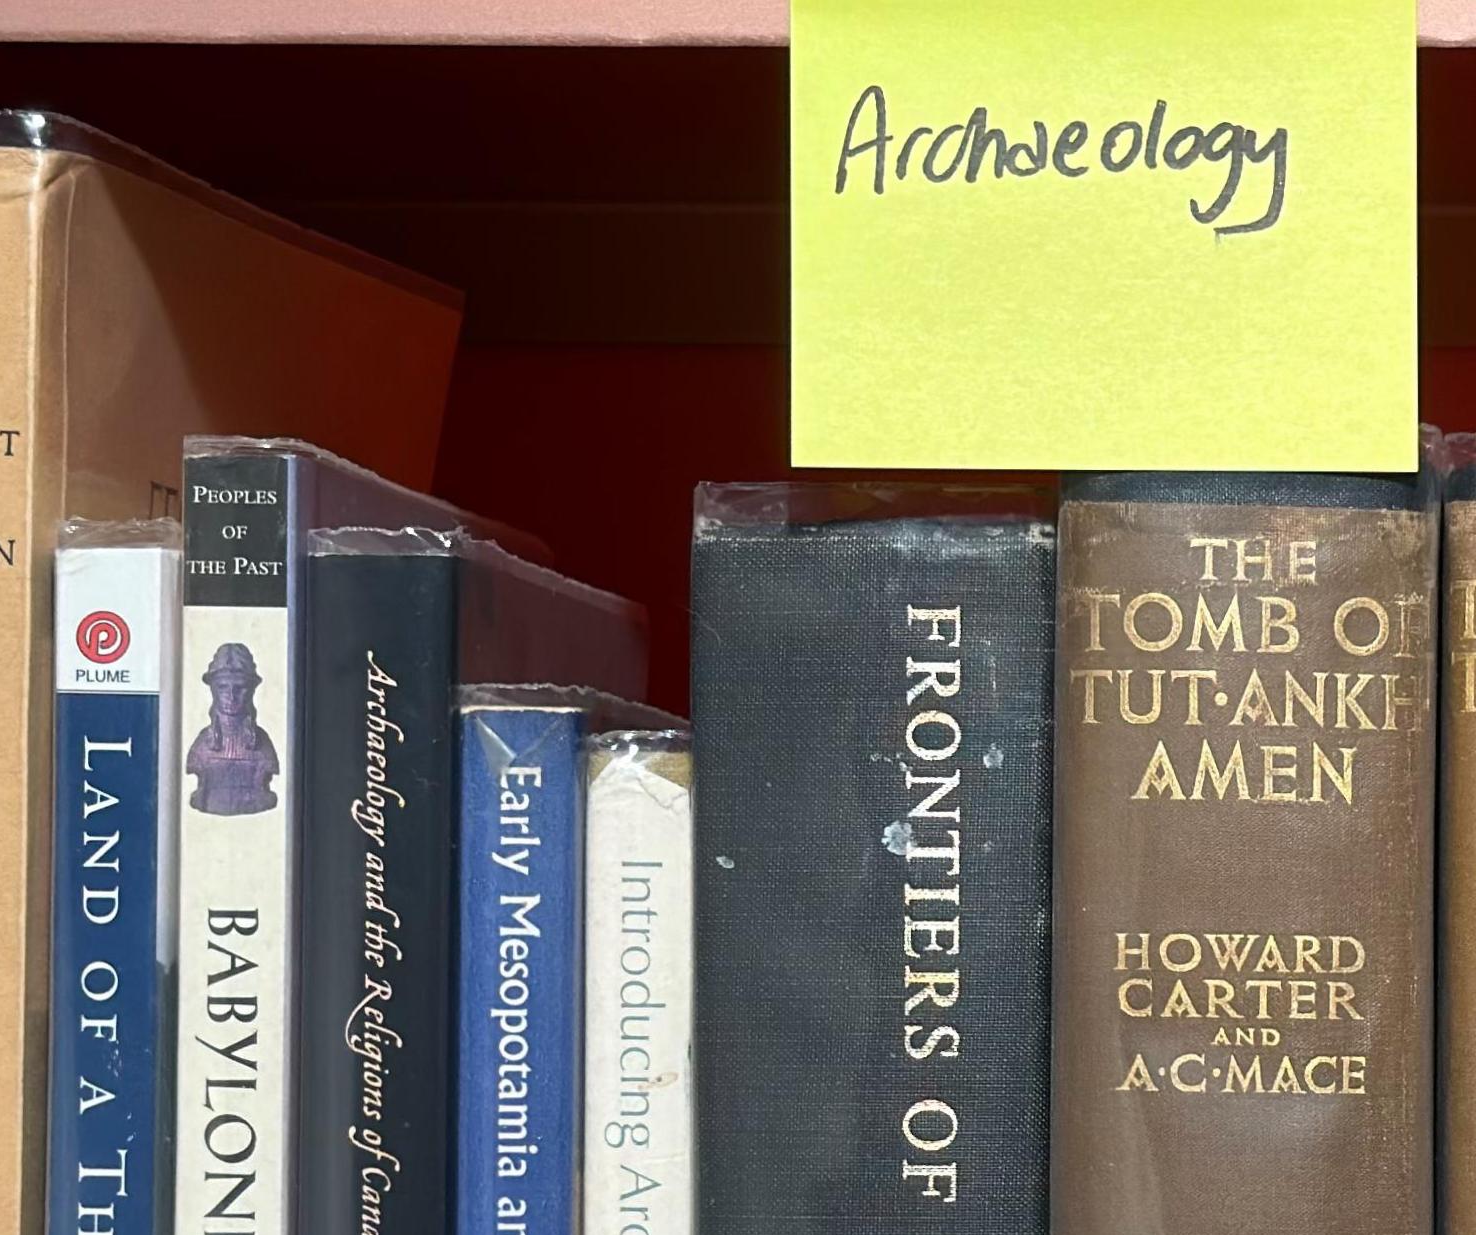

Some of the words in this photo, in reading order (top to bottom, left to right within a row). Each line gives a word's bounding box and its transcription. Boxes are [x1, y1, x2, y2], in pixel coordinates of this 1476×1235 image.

[836, 84, 1288, 236] Archaeology
[222, 525, 247, 540] OF
[1189, 537, 1319, 585] THE
[187, 560, 226, 575] THE
[1067, 591, 1299, 655] TOMB
[76, 669, 130, 682] PLUME
[349, 650, 404, 847] Archaeology
[1130, 740, 1356, 804] AMEN
[83, 735, 132, 925] LAND
[491, 765, 542, 876] Early
[901, 605, 962, 1058] FRONTIERS
[365, 851, 402, 929] and
[364, 920, 402, 968] the
[1113, 932, 1366, 975] HOWARD
[80, 960, 118, 1042] OF
[604, 861, 665, 1148] Introducing
[1118, 977, 1364, 1020] CARTER
[345, 974, 402, 1121] Religions
[489, 895, 541, 1178] Mesopotamia
[1211, 1027, 1280, 1047] AND
[79, 1077, 115, 1114] A
[348, 1126, 401, 1171] of
[901, 1098, 958, 1203] OF
